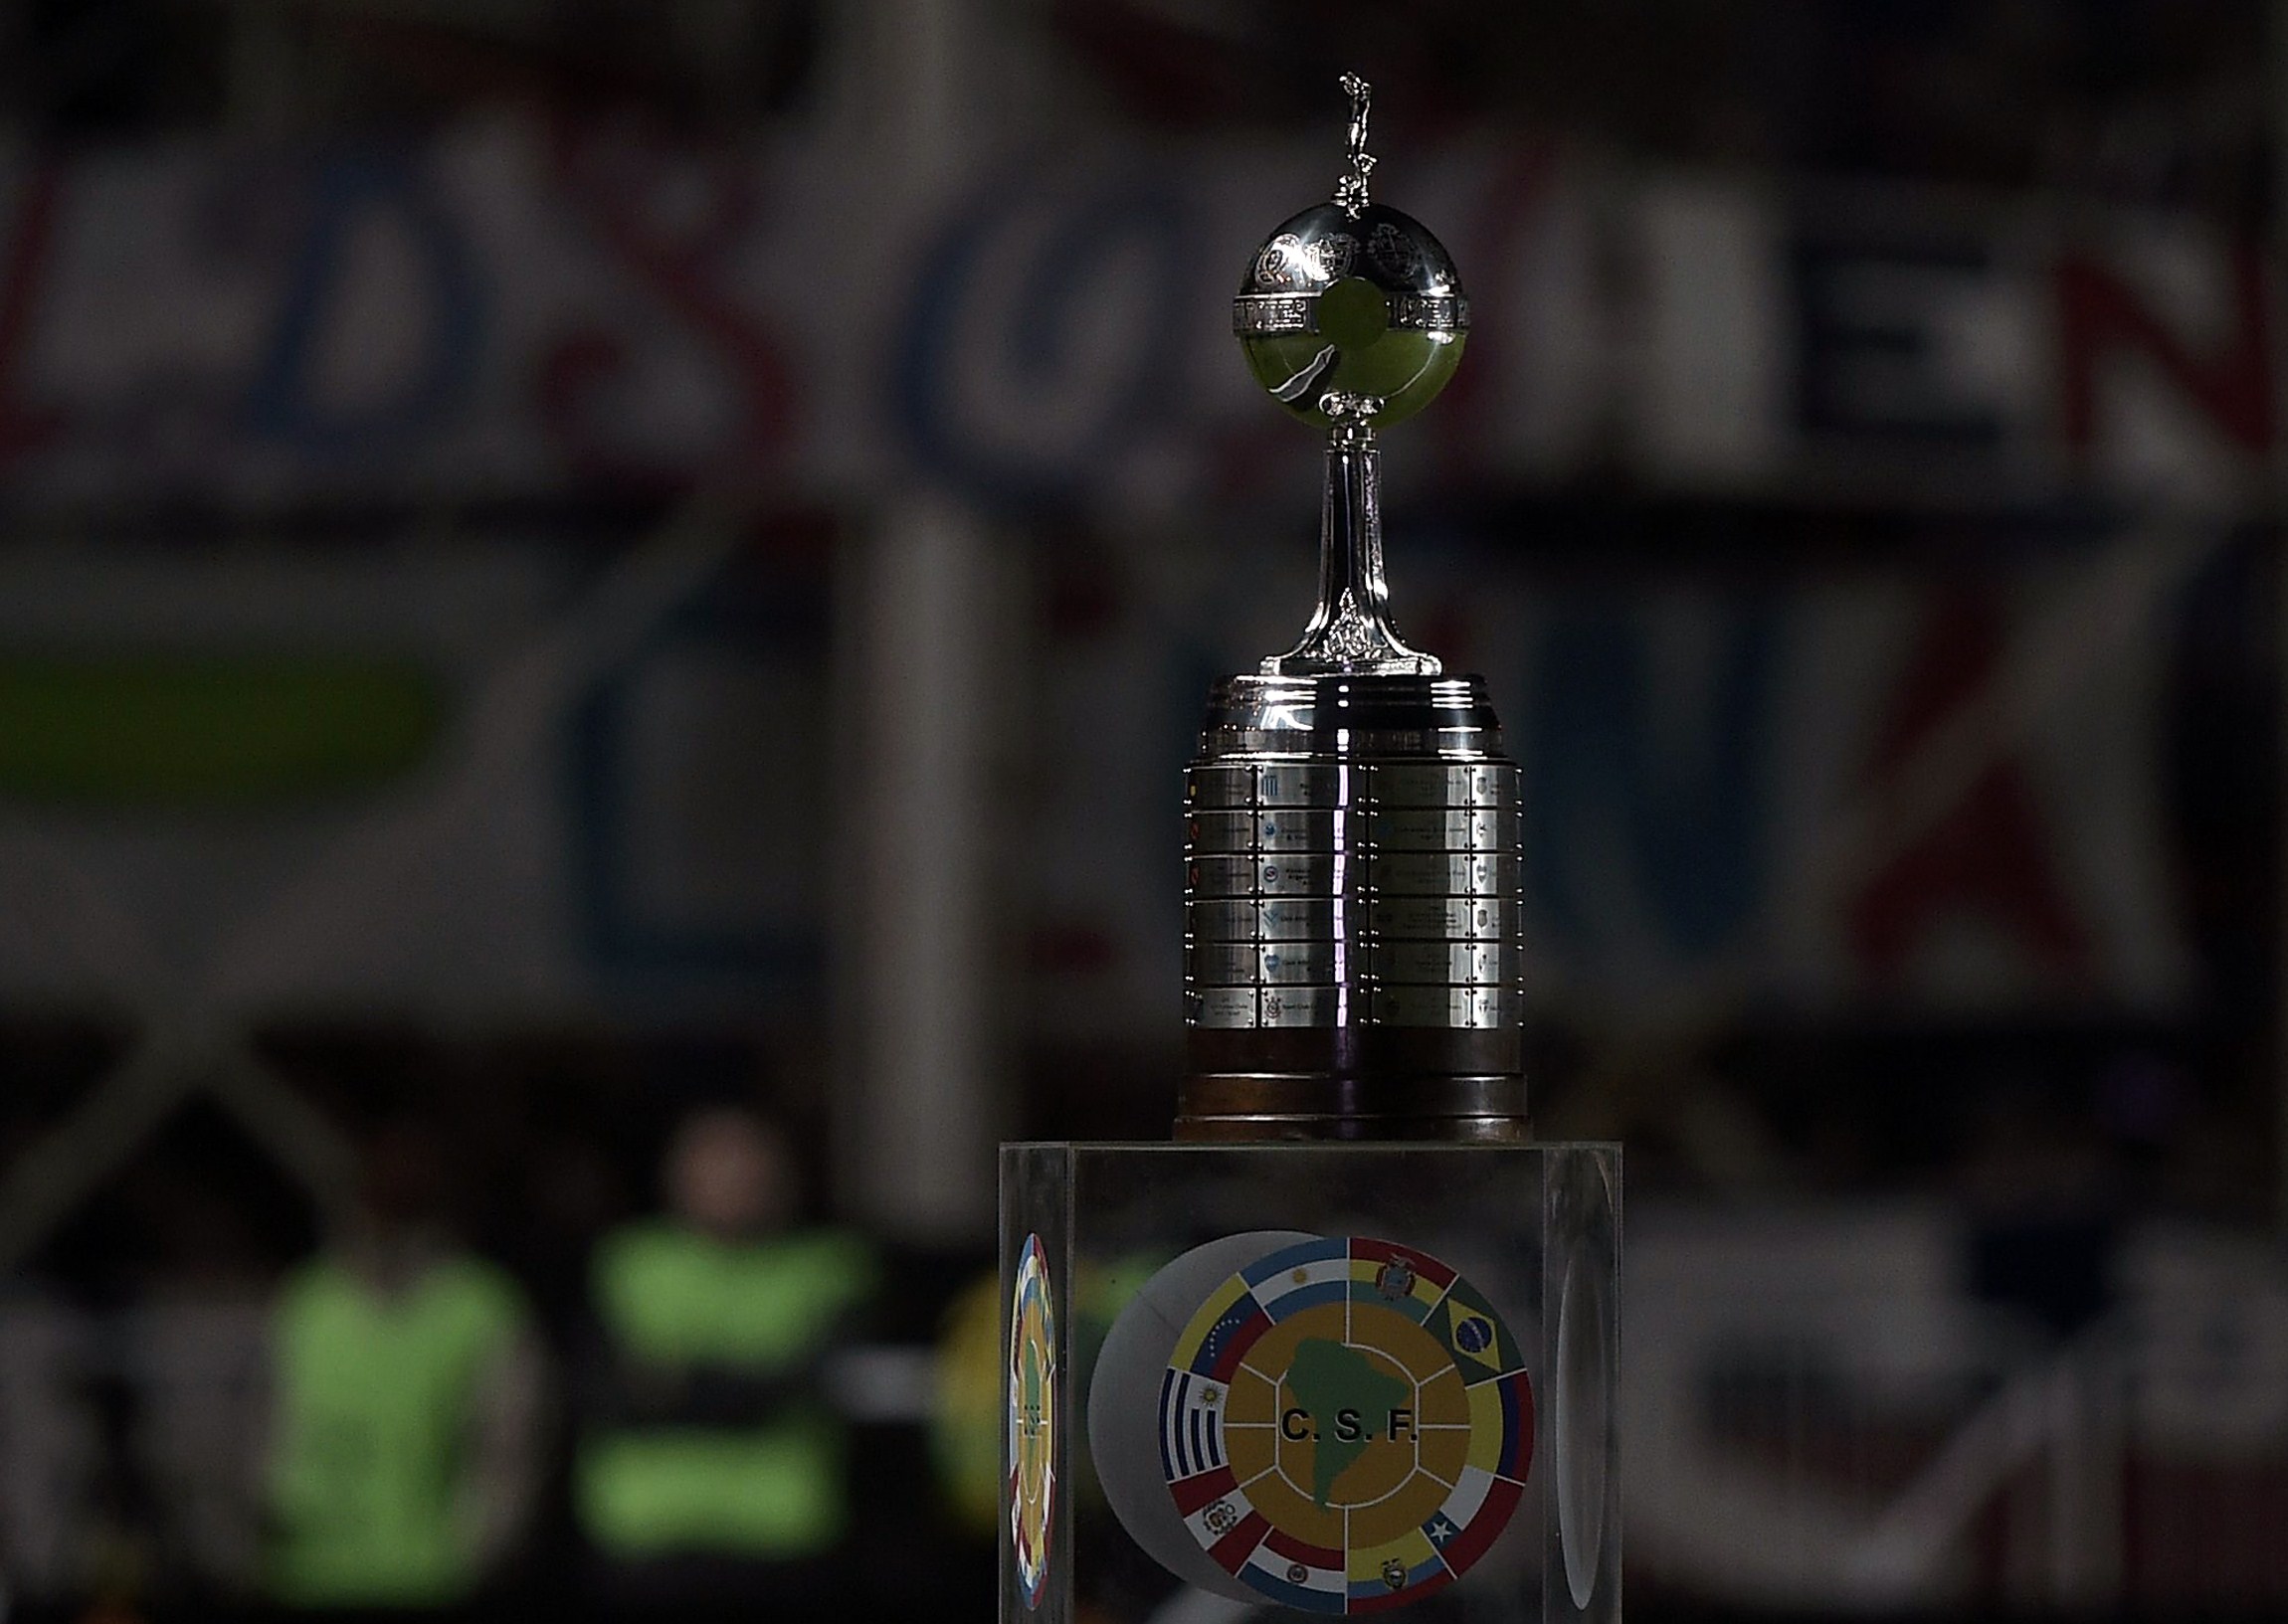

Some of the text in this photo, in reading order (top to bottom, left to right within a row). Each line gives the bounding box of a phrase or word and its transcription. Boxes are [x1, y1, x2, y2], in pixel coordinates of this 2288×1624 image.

[1281, 1407, 1418, 1443] C. S. F.
